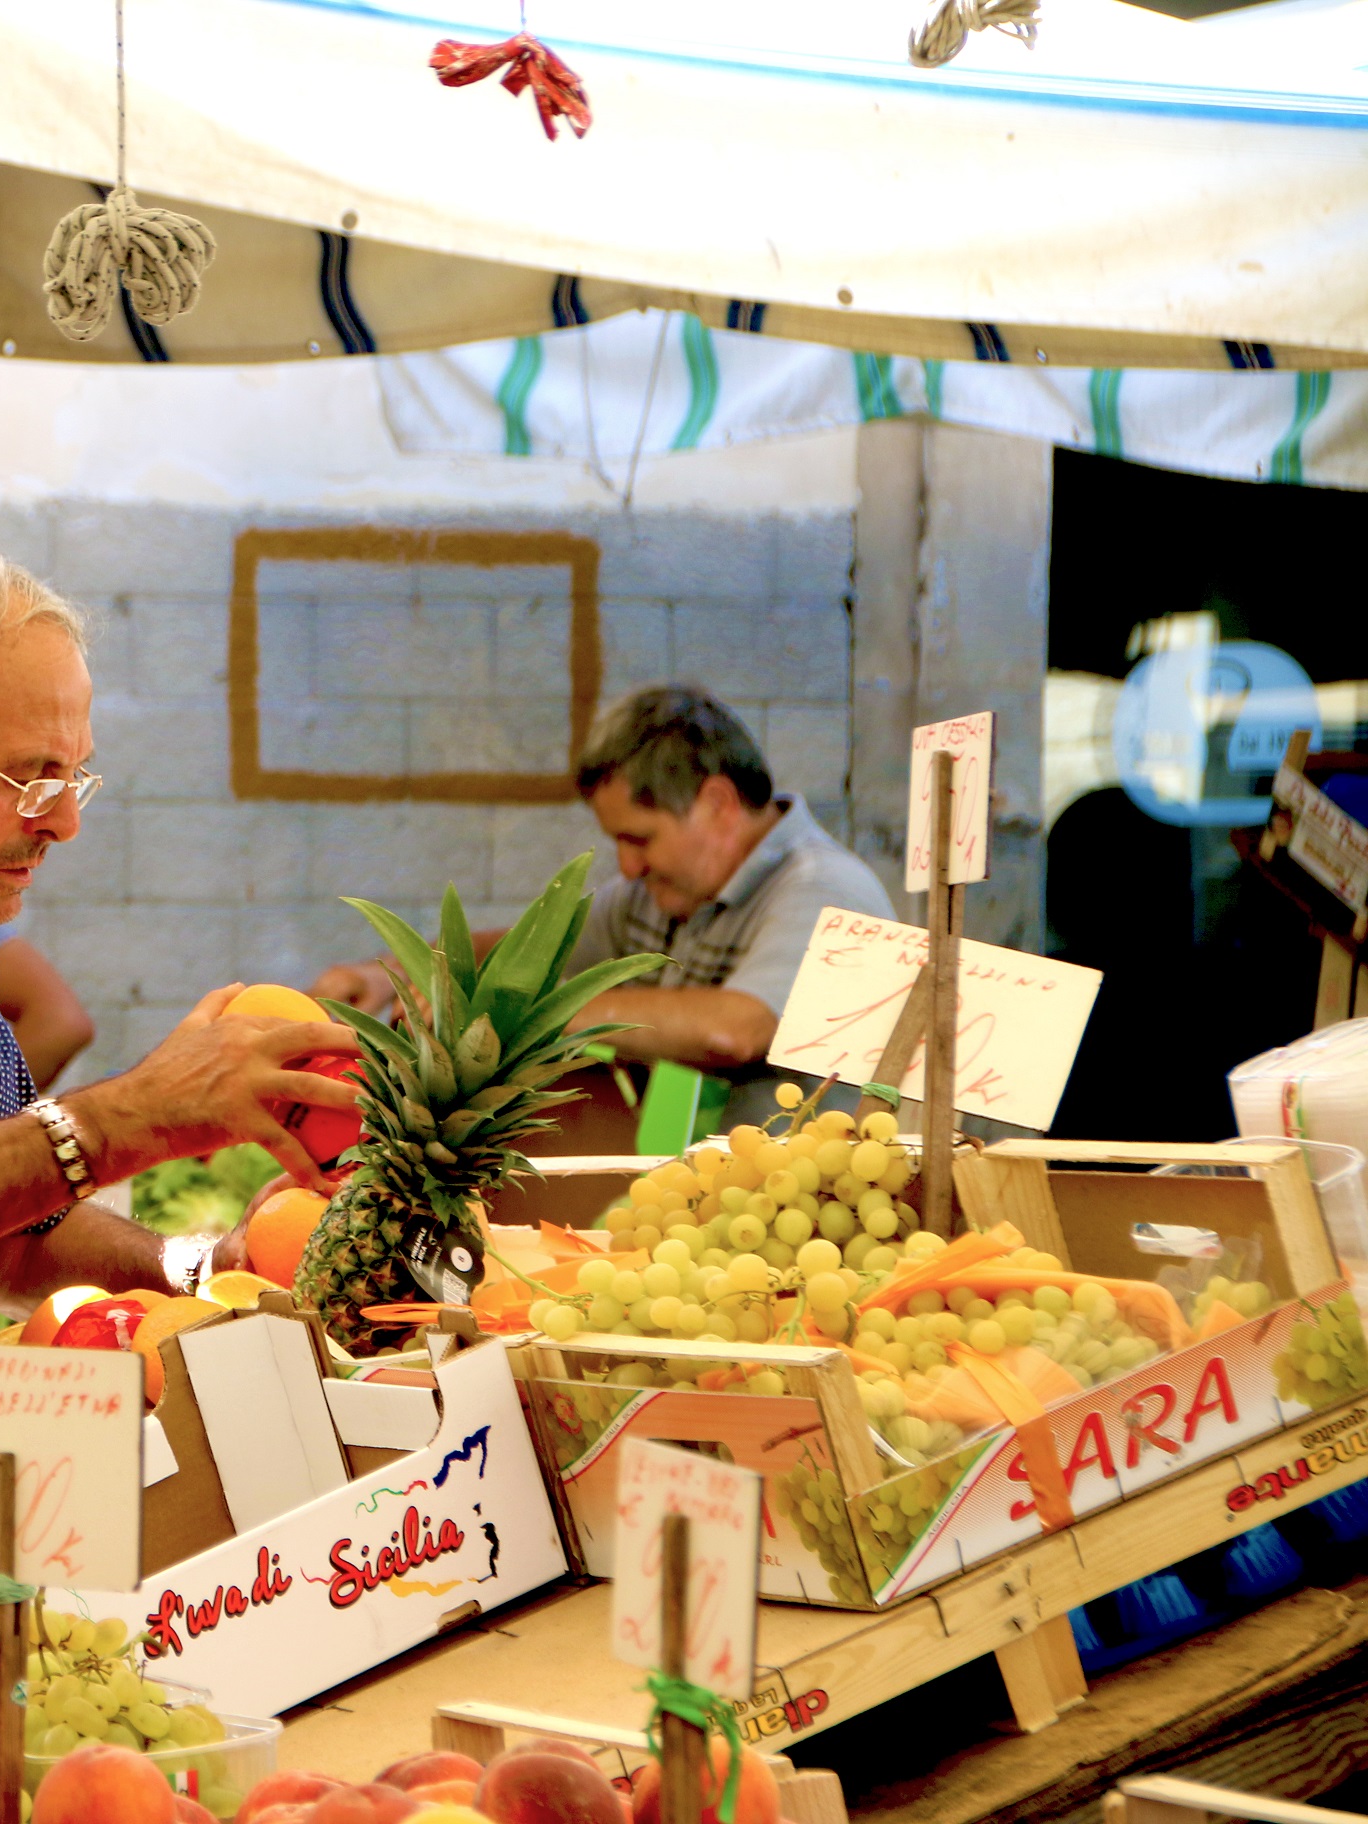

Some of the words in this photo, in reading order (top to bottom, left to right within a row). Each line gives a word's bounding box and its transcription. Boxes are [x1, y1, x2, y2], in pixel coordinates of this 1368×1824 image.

[896, 950, 1058, 991] NOLLINO
[927, 1484, 969, 1539] AGRICOLA
[327, 1505, 465, 1608] Sicilia
